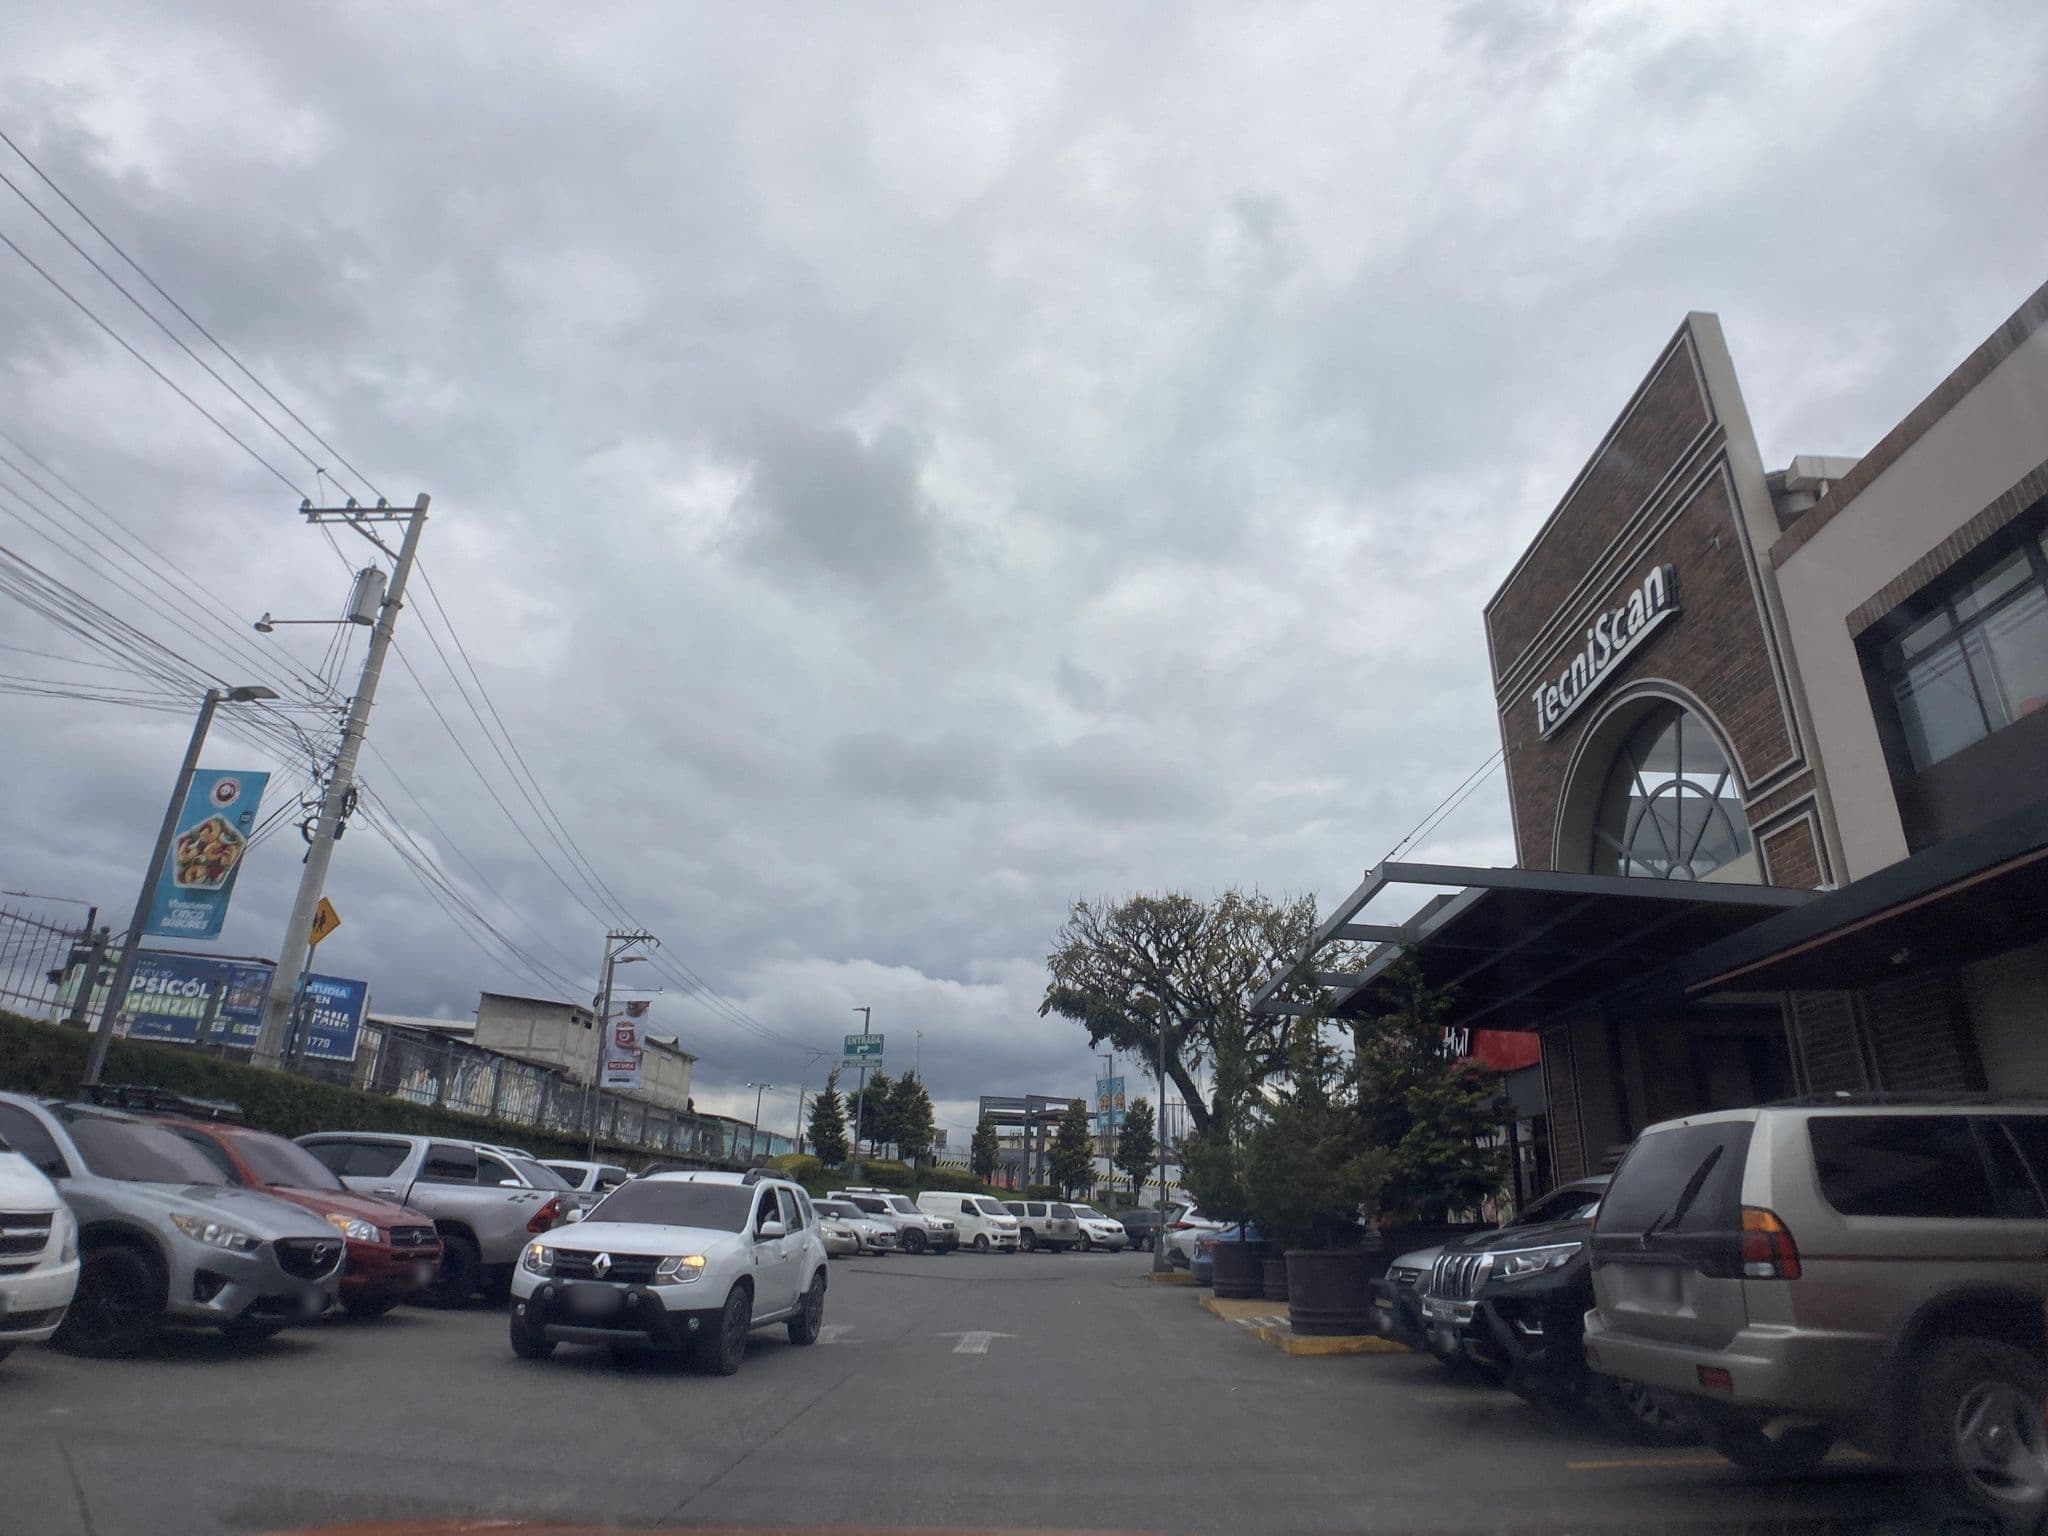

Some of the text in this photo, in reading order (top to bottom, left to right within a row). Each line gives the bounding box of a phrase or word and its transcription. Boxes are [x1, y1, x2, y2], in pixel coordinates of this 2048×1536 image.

[1532, 564, 1671, 735] TecniScan
[129, 975, 227, 1000] PSICÓL
[315, 995, 331, 1005] EN
[847, 1035, 881, 1045] ENTRADA
